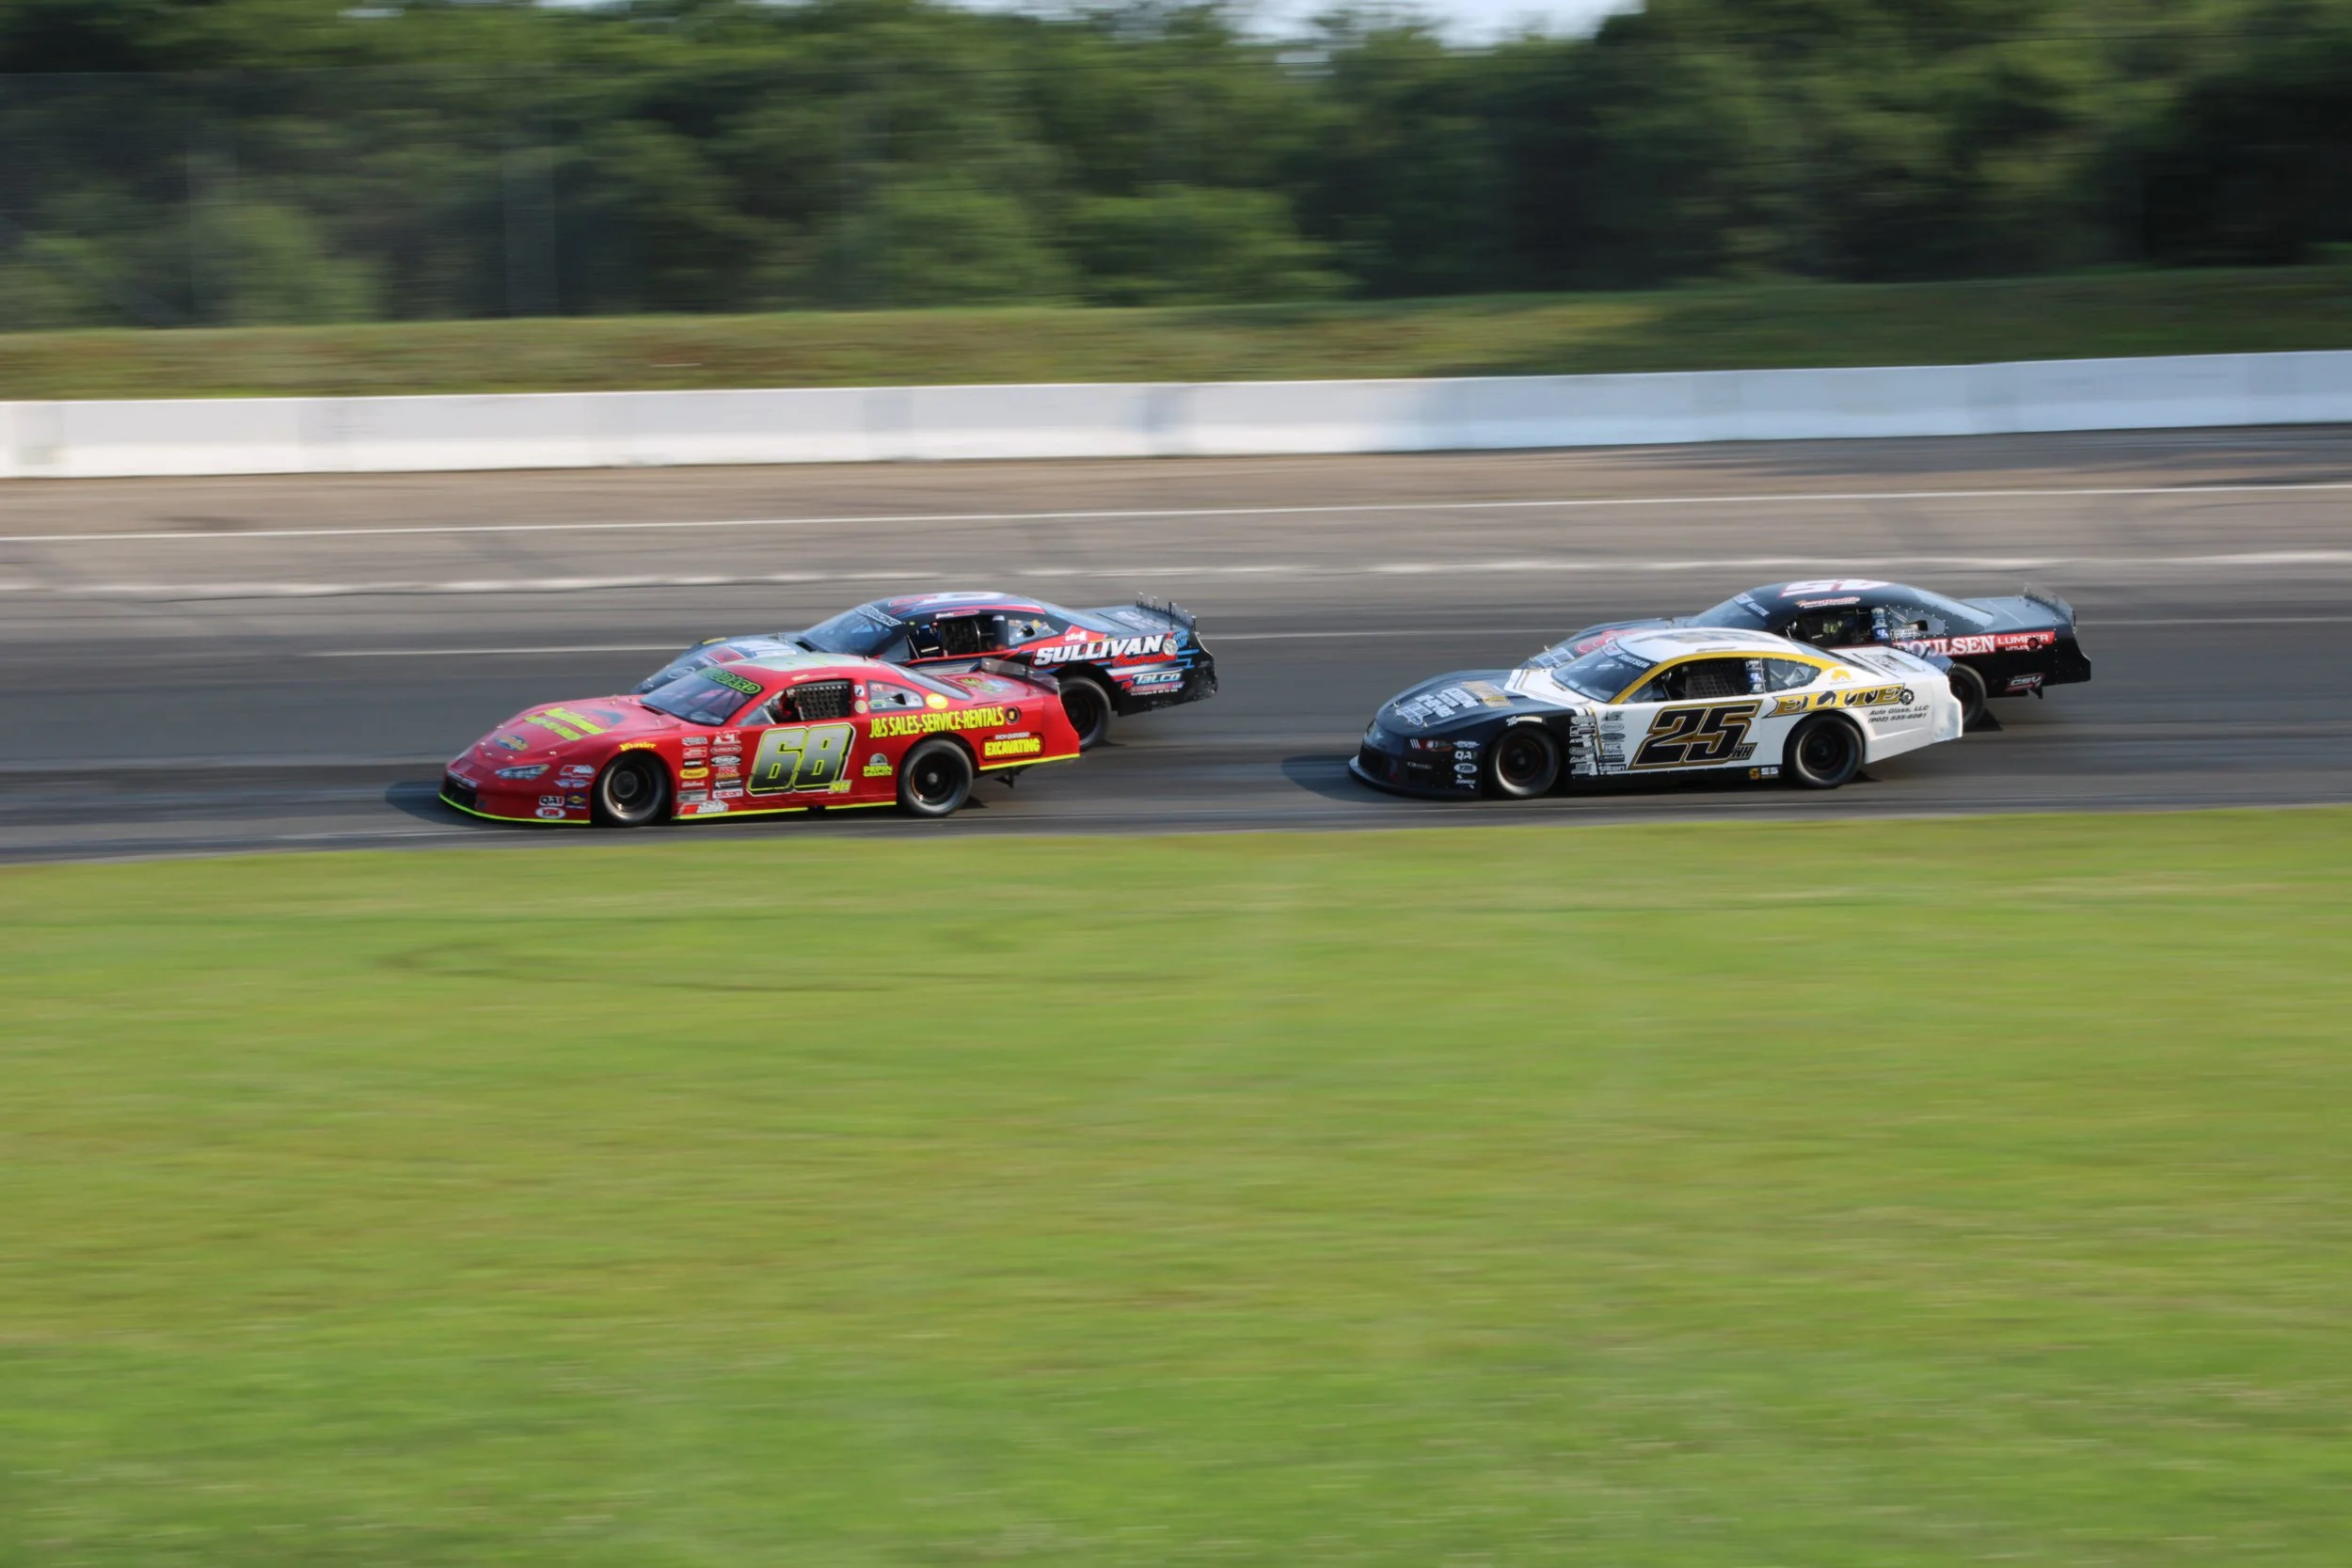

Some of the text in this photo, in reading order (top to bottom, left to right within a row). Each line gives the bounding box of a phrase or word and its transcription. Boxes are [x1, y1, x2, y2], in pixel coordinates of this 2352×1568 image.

[1033, 635, 1164, 666] SULLIVAN
[869, 706, 1006, 738] J&S SALES-SERVICE-RENTALS
[1628, 699, 1762, 770] 25
[746, 722, 856, 797] 68
[984, 737, 1041, 756] EXCAVATING
